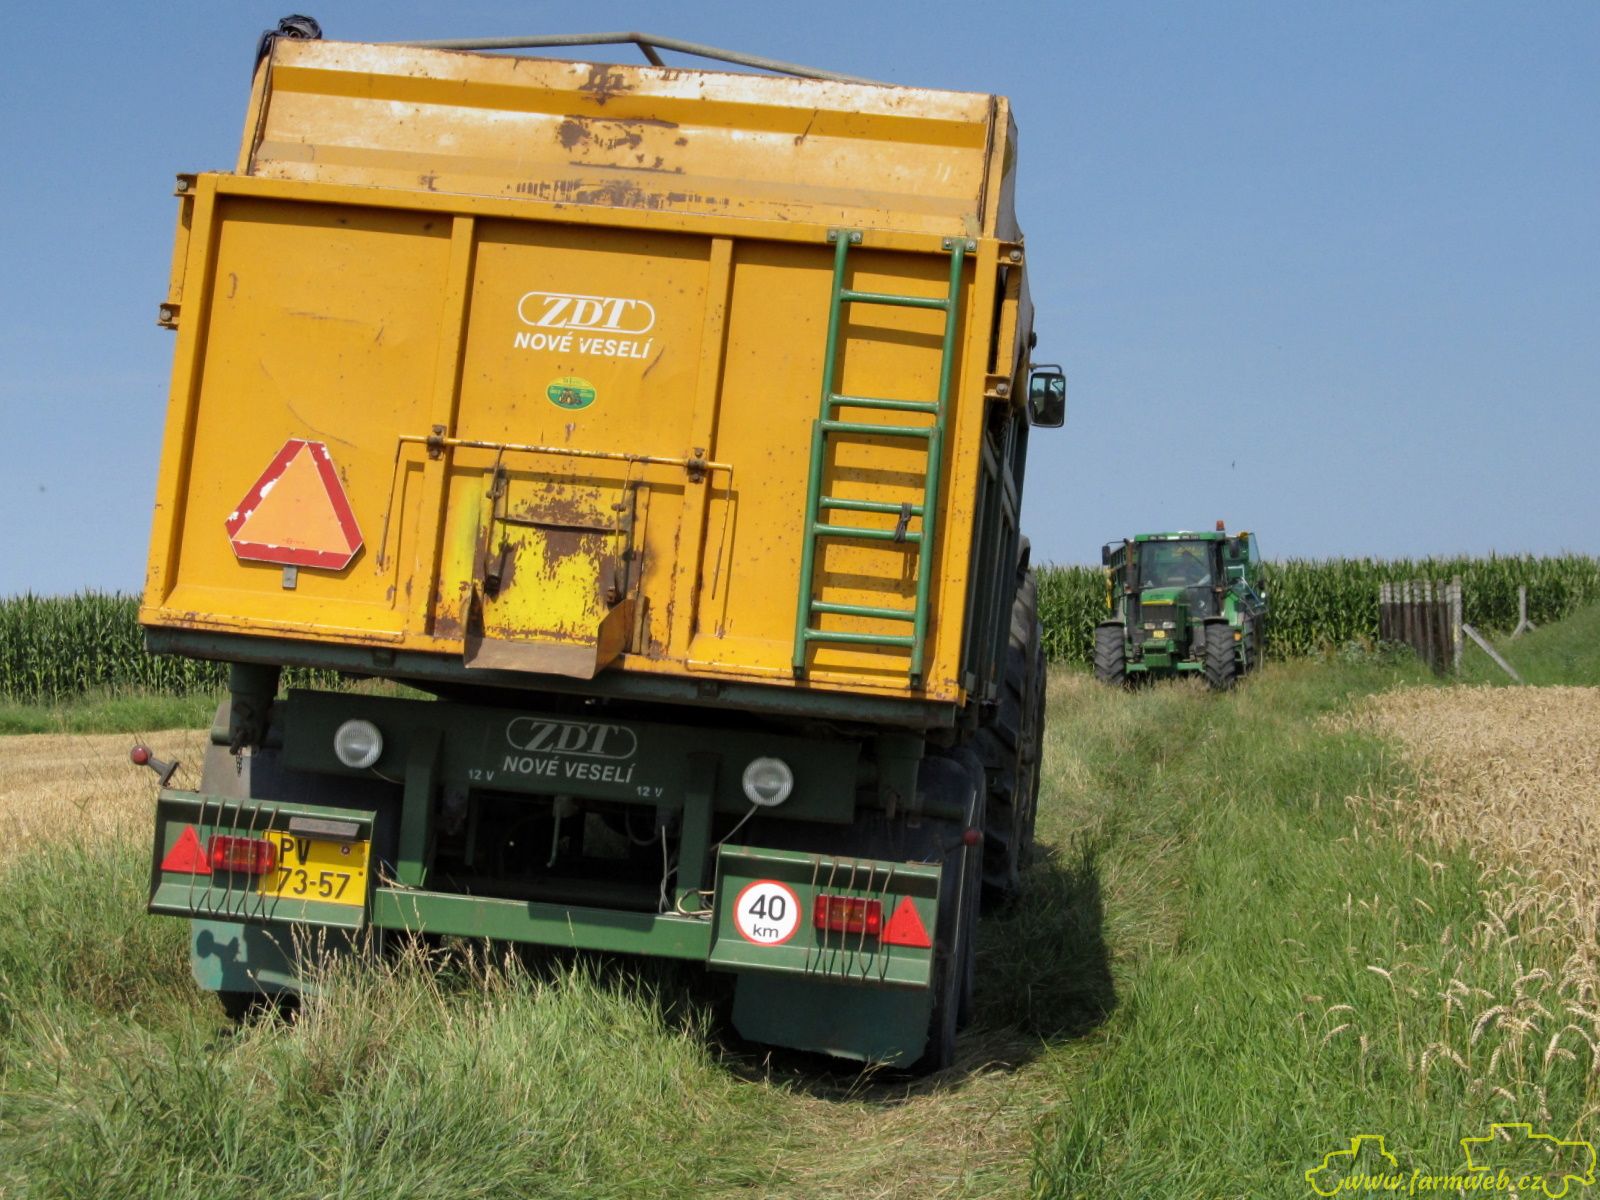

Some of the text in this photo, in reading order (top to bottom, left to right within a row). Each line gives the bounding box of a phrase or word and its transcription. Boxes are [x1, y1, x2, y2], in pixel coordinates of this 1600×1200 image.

[536, 296, 638, 329] ZDT
[513, 331, 654, 359] NOVÉ VESELÍ
[523, 721, 620, 754] ZDT
[468, 769, 495, 782] 12 V
[502, 755, 636, 784] NOVÉ VESELÍ
[636, 785, 664, 798] 12 V
[279, 837, 311, 866] PV
[278, 867, 351, 900] 73-57
[748, 894, 786, 922] 40
[752, 923, 780, 939] km
